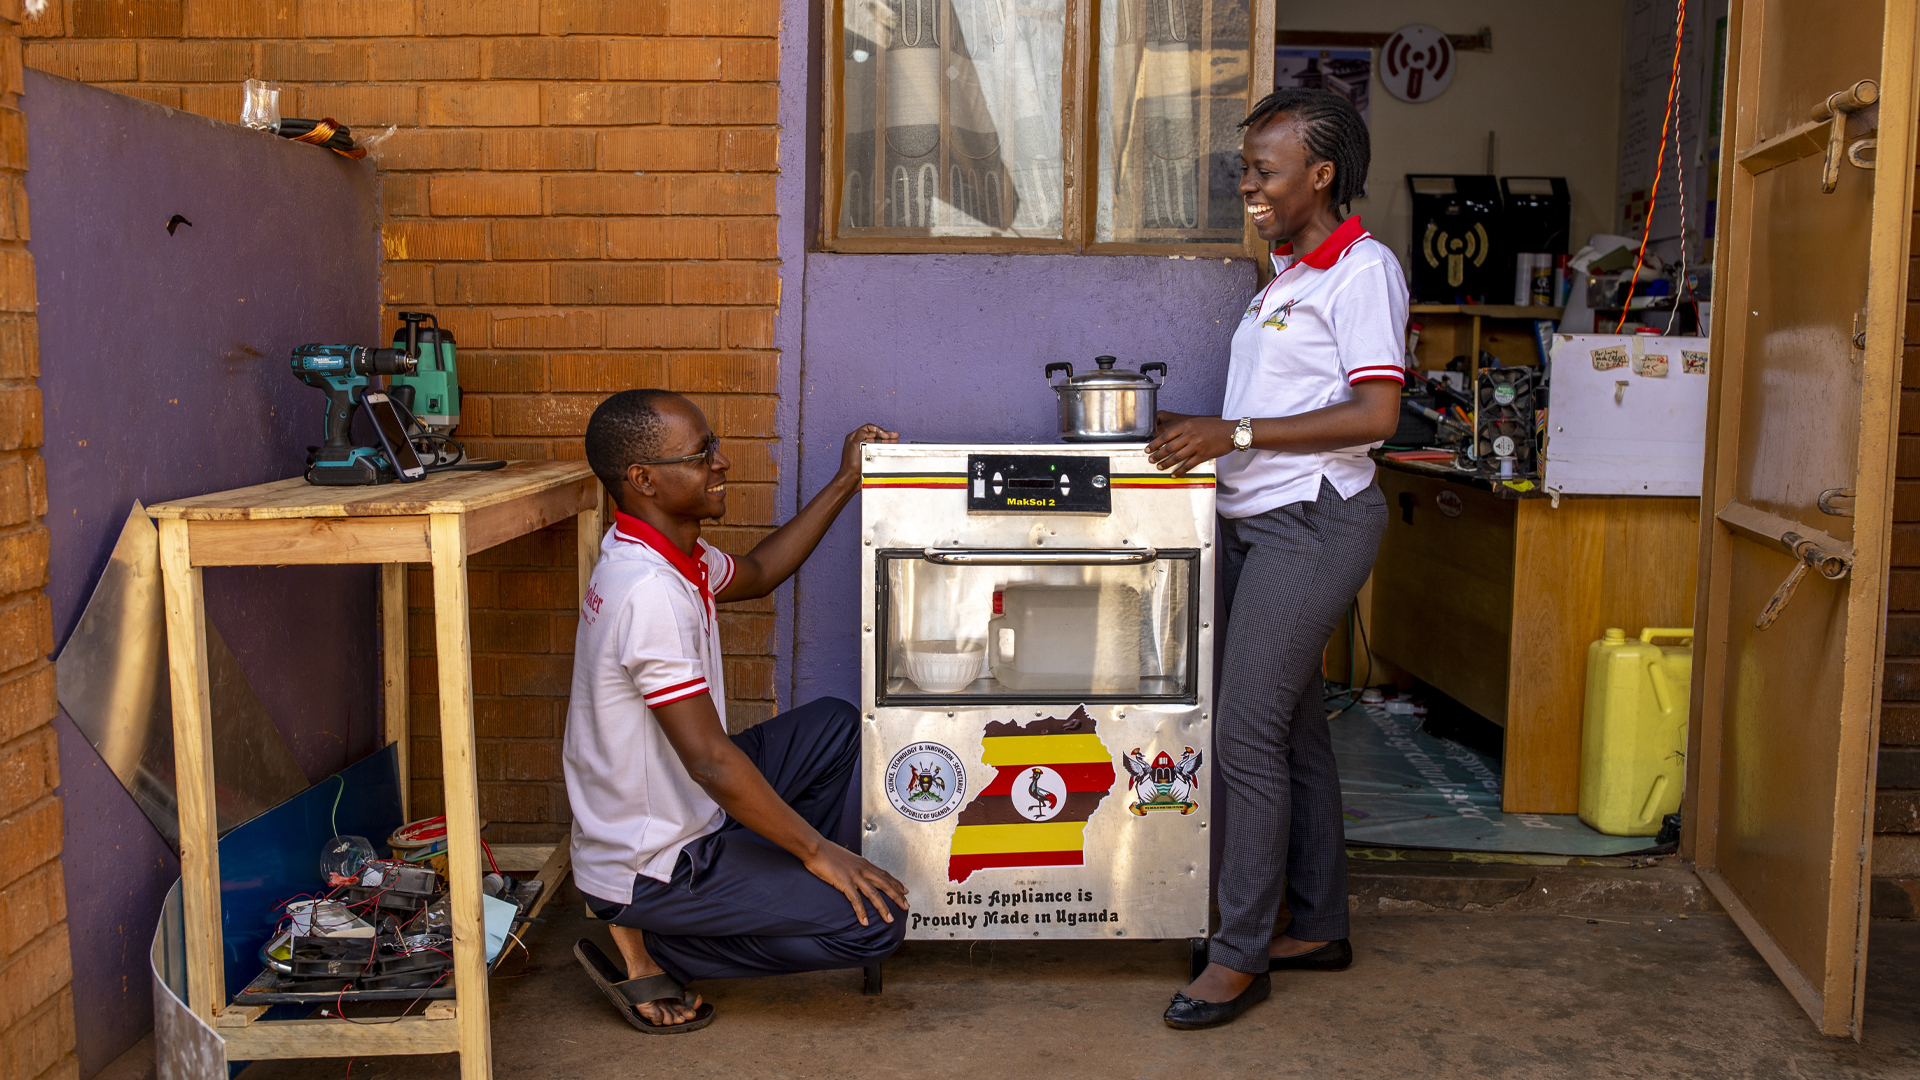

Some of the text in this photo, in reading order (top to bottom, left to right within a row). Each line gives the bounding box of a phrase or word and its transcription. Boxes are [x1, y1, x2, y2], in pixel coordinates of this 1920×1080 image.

[1006, 497, 1056, 507] MakSol 2
[891, 746, 918, 770] TECHNOLOGY
[925, 745, 955, 761] INNOVATION
[953, 762, 964, 795] SECRETARIAT
[1384, 736, 1467, 787] agrcultural
[900, 805, 924, 819] REPUBLIC
[931, 805, 951, 819] UGANDA
[946, 888, 1093, 907] This Appliance is
[911, 909, 1119, 930] Proudly Made in Uganda
